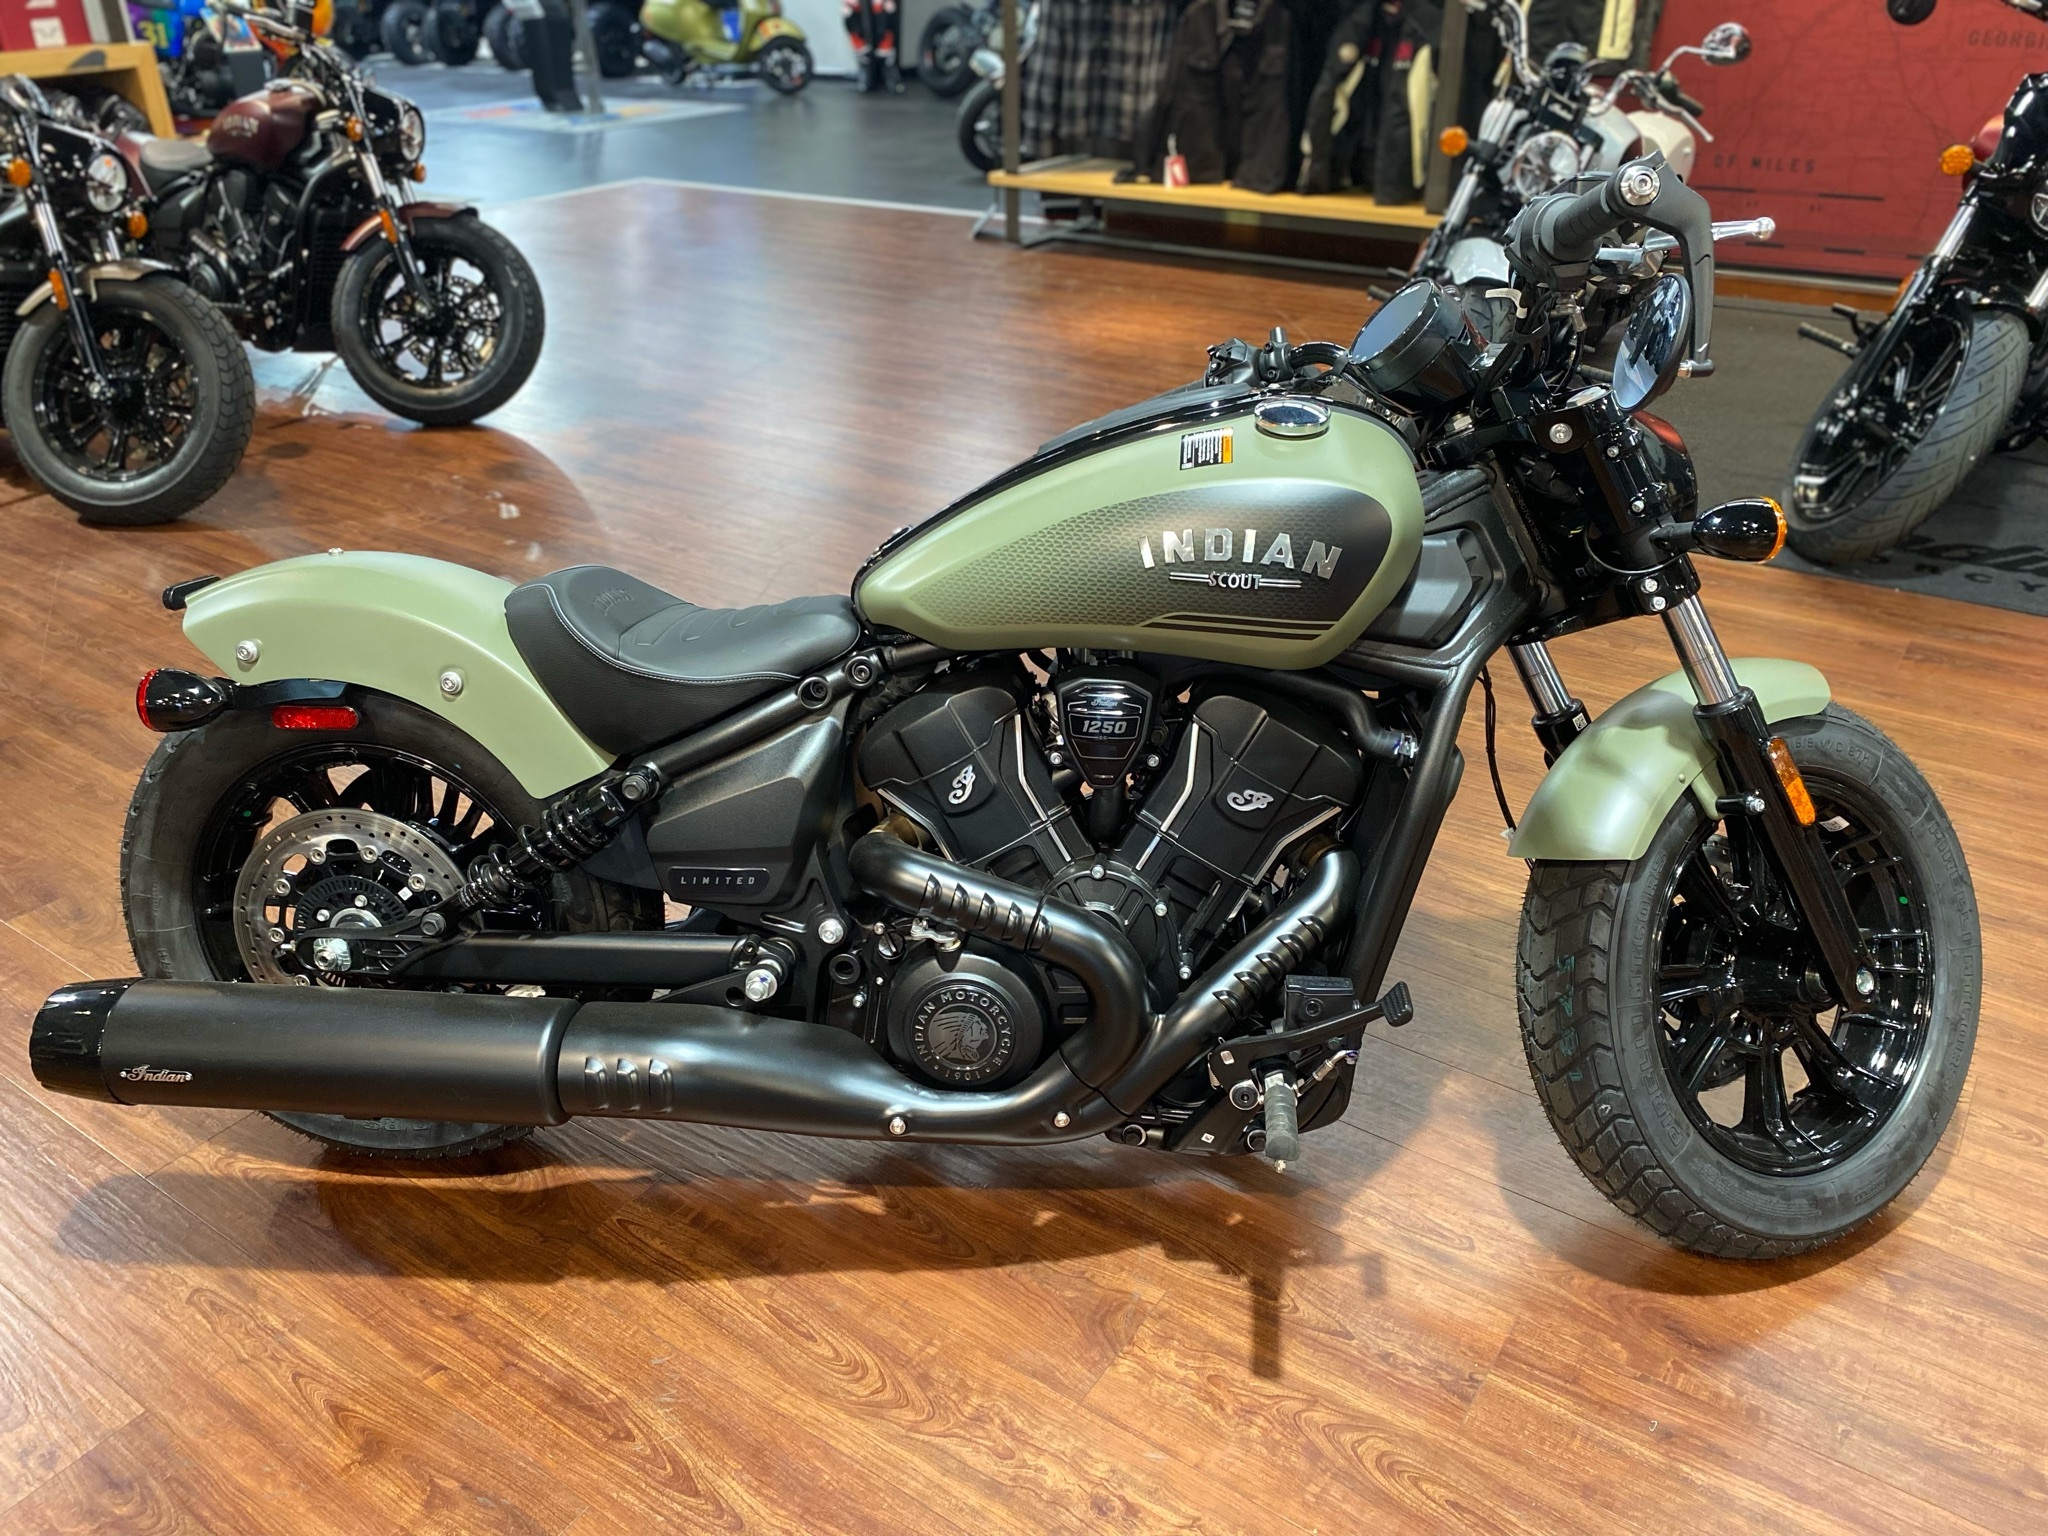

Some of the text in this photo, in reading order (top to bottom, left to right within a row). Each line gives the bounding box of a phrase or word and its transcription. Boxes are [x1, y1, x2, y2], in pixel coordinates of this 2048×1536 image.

[1751, 154, 1816, 174] MILES
[1137, 527, 1343, 580] INDIAN
[1208, 570, 1262, 591] SCOUT
[1090, 698, 1119, 708] Indian
[1082, 720, 1127, 734] 1250
[680, 876, 756, 885] LIMITED
[914, 990, 1012, 1067] INDIAN MOTORCYCLE
[127, 1063, 186, 1083] Indian
